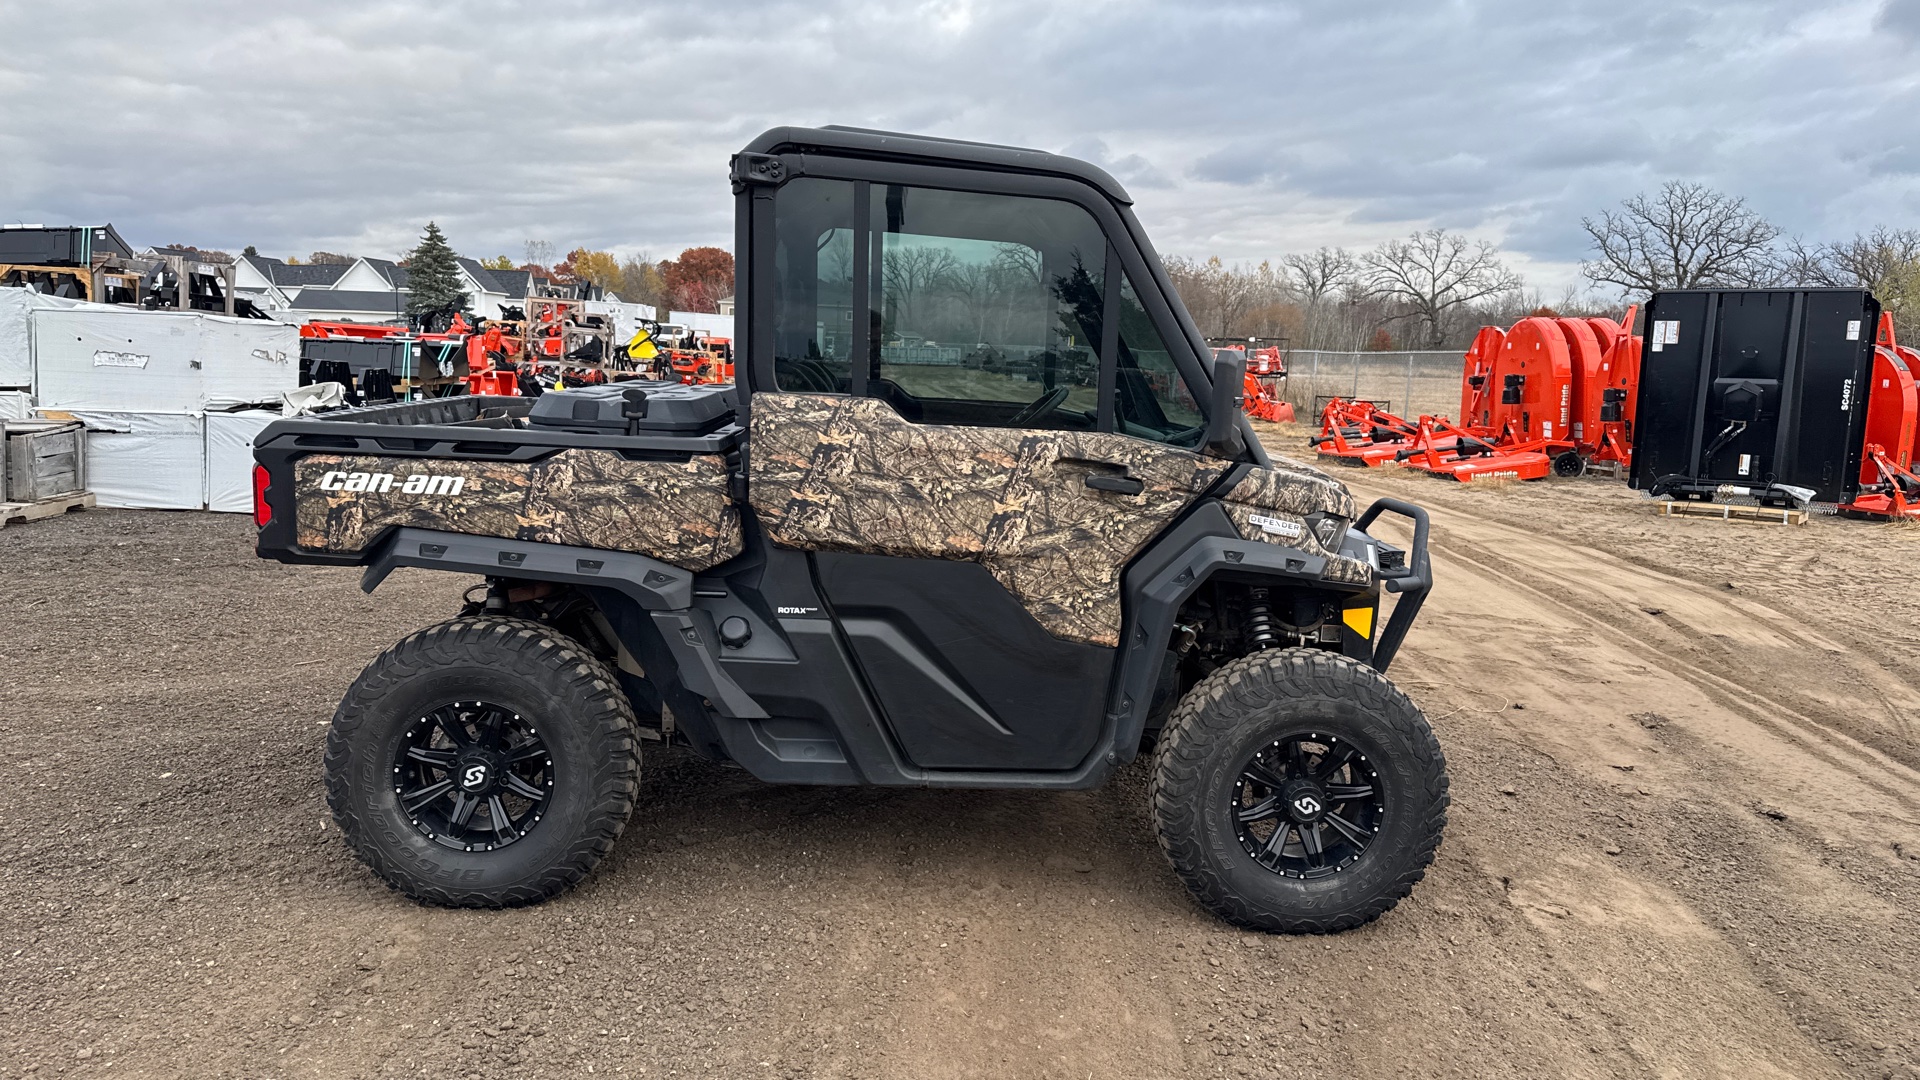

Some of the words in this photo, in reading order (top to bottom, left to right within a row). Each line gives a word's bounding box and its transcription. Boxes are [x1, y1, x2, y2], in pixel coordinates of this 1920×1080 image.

[1561, 384, 1569, 406] Pride
[1841, 379, 1852, 411] SC4072
[1559, 407, 1568, 427] Land
[320, 471, 465, 495] can-am
[1250, 515, 1300, 530] DEFENDER
[777, 606, 806, 614] ROTAX
[361, 740, 485, 882] BFGoodrich
